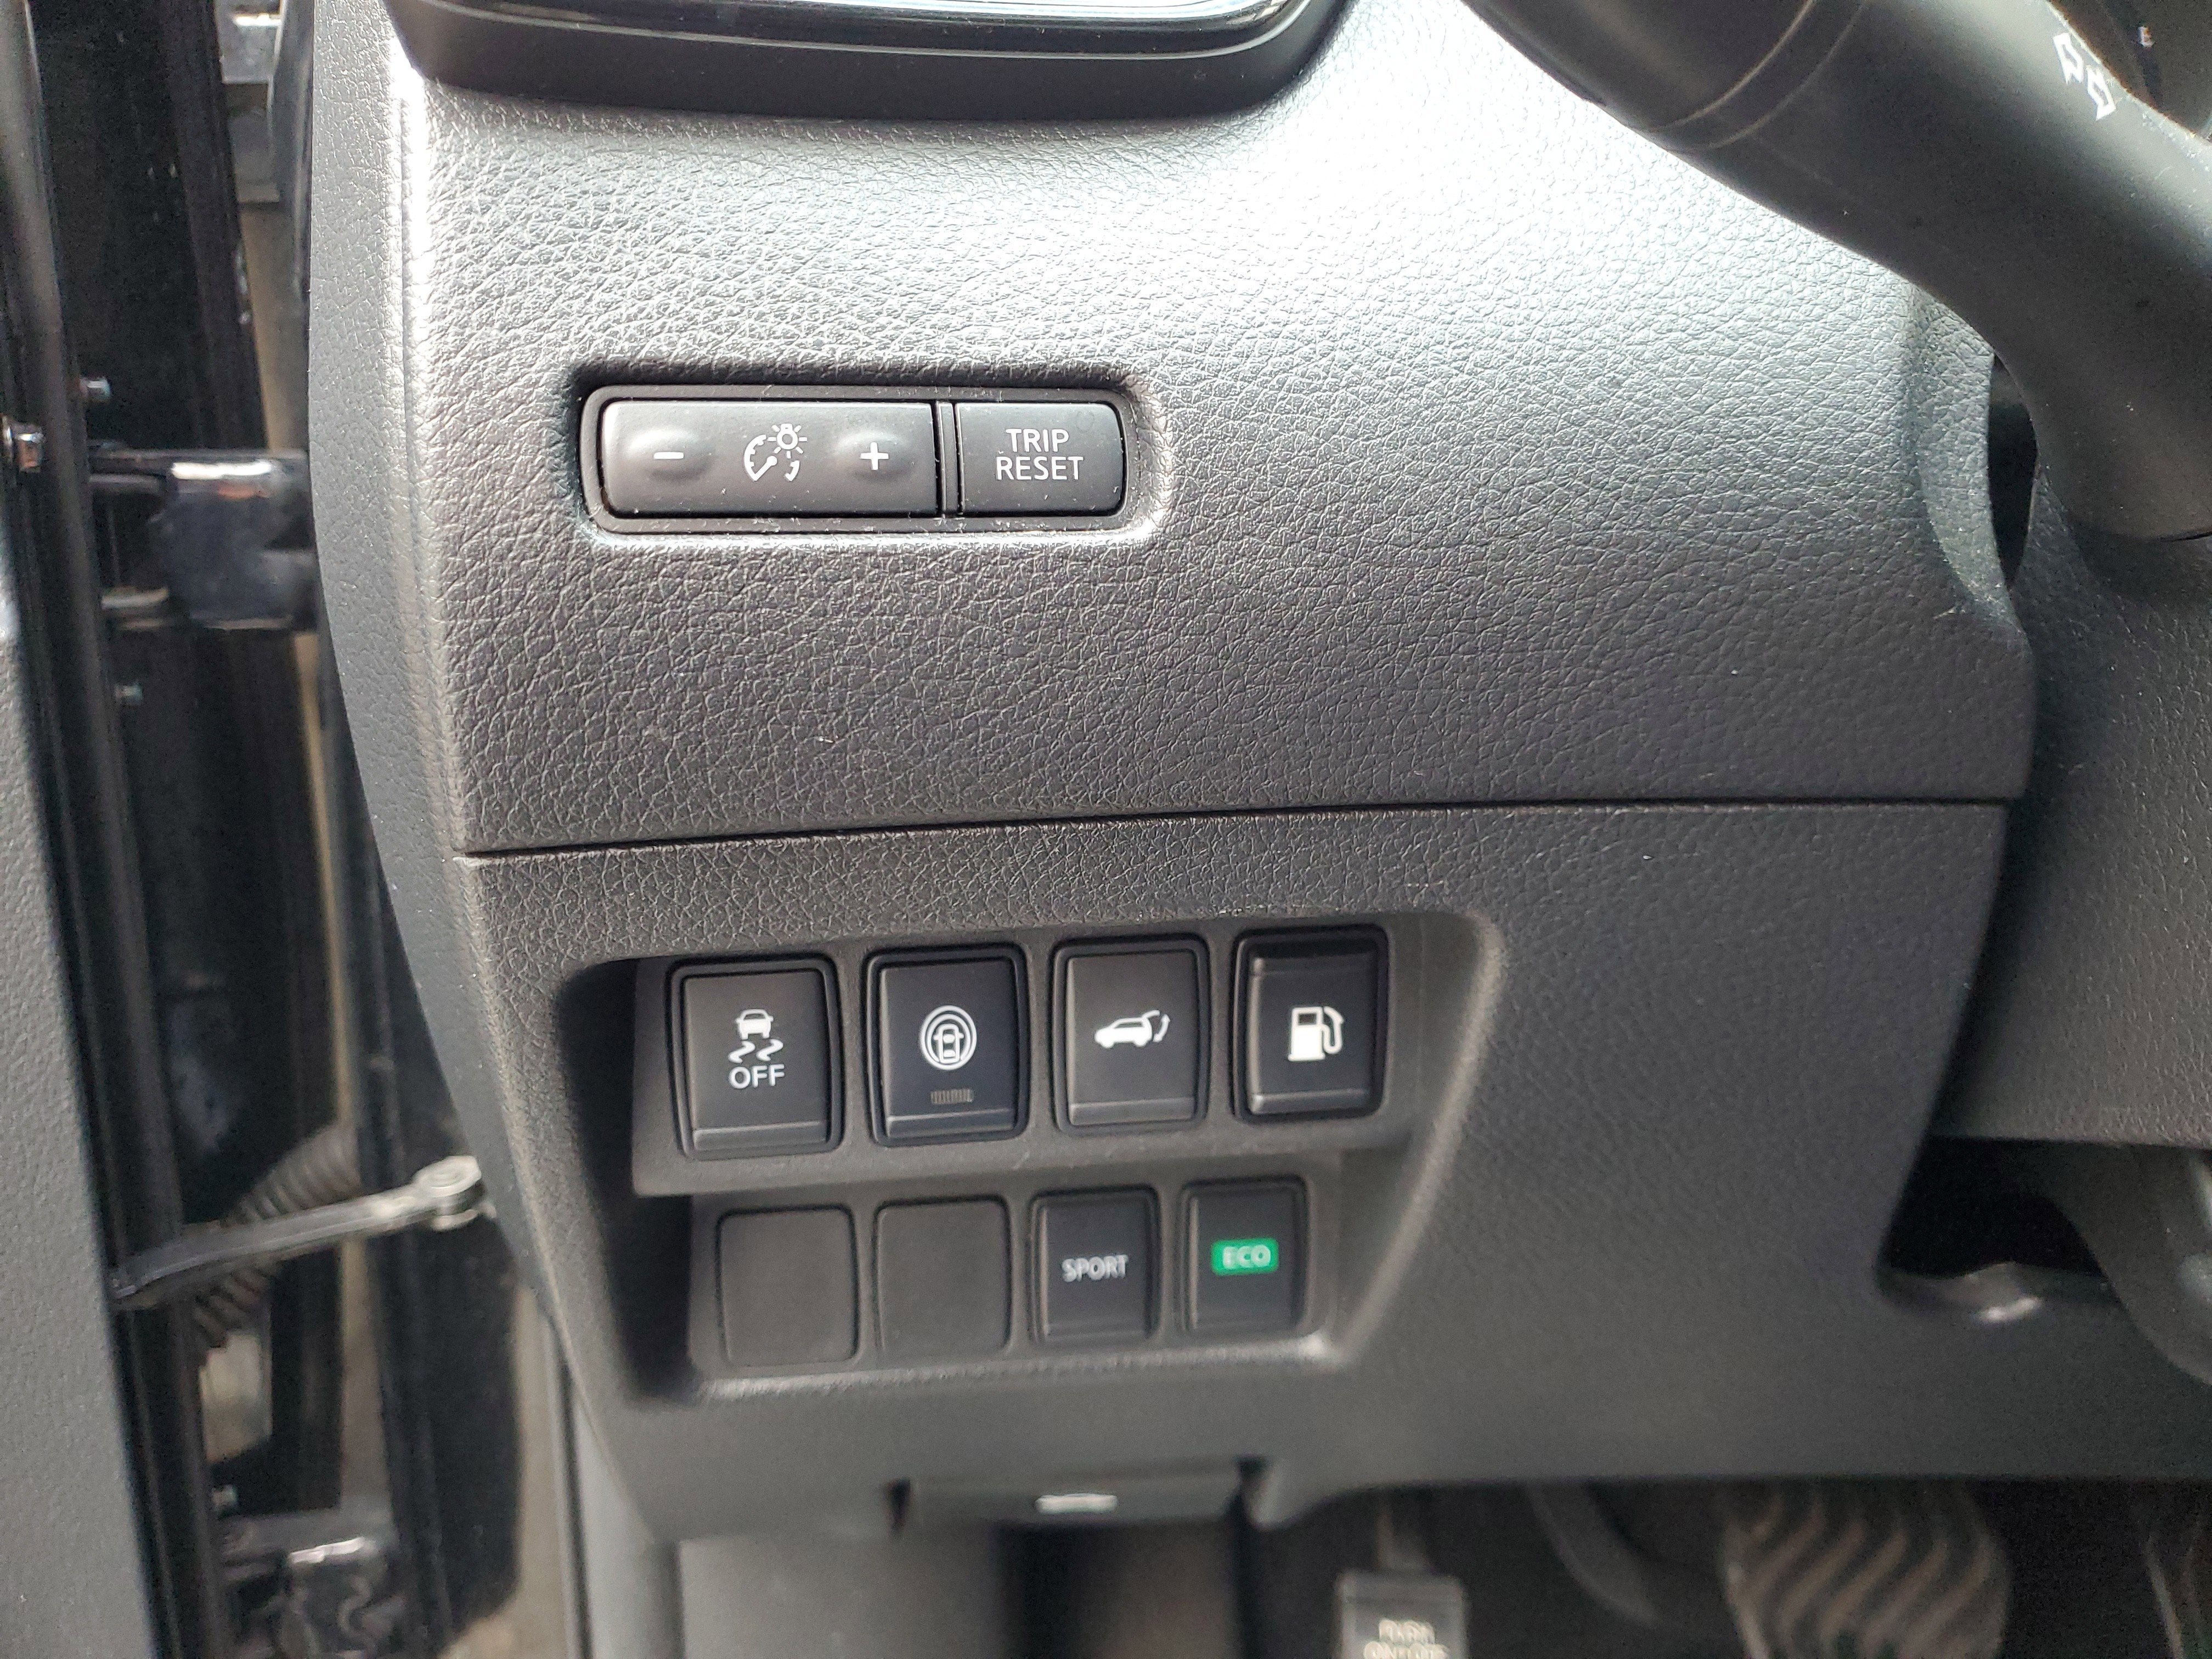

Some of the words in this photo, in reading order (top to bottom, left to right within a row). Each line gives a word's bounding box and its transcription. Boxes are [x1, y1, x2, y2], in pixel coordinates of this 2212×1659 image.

[1006, 428, 1069, 452] TRIP
[996, 456, 1084, 481] RESET
[729, 1063, 785, 1089] OFF
[1061, 1254, 1128, 1283] SPORT
[1222, 1244, 1271, 1269] ECO
